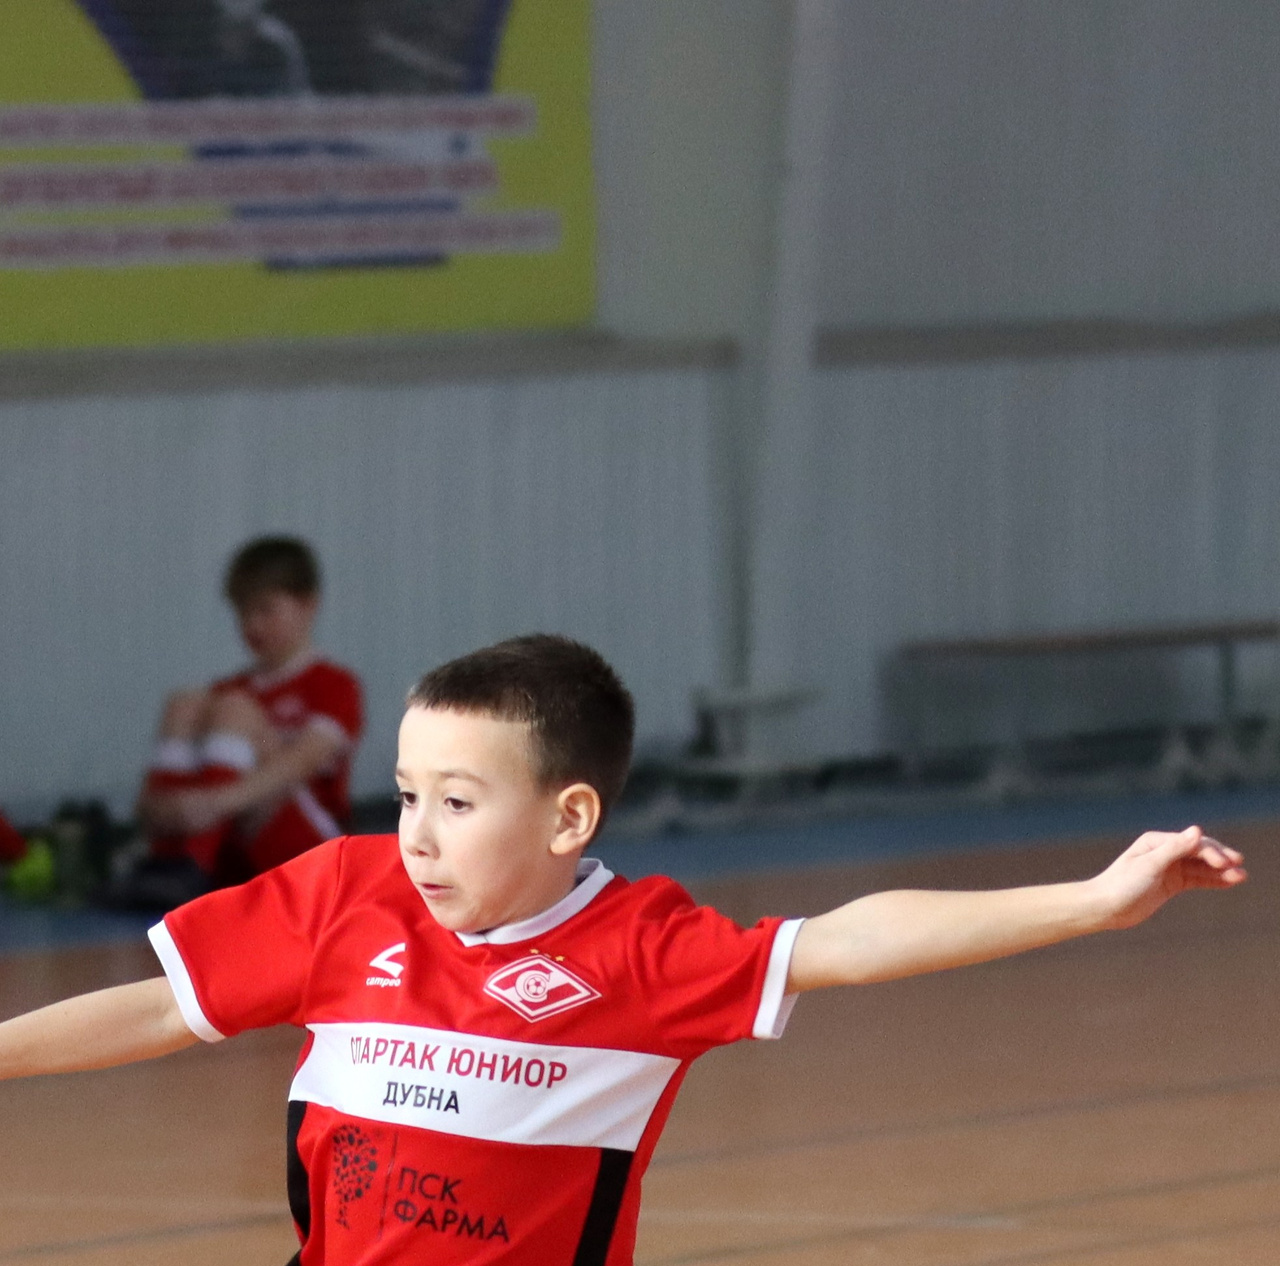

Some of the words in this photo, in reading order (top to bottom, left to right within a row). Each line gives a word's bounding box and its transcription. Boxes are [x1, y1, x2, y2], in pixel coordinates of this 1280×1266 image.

[446, 1047, 568, 1089] ЮНИОР
[382, 1081, 460, 1114] ДУБНА
[397, 1166, 463, 1204] ПСК
[393, 1199, 510, 1244] ФАРМА
